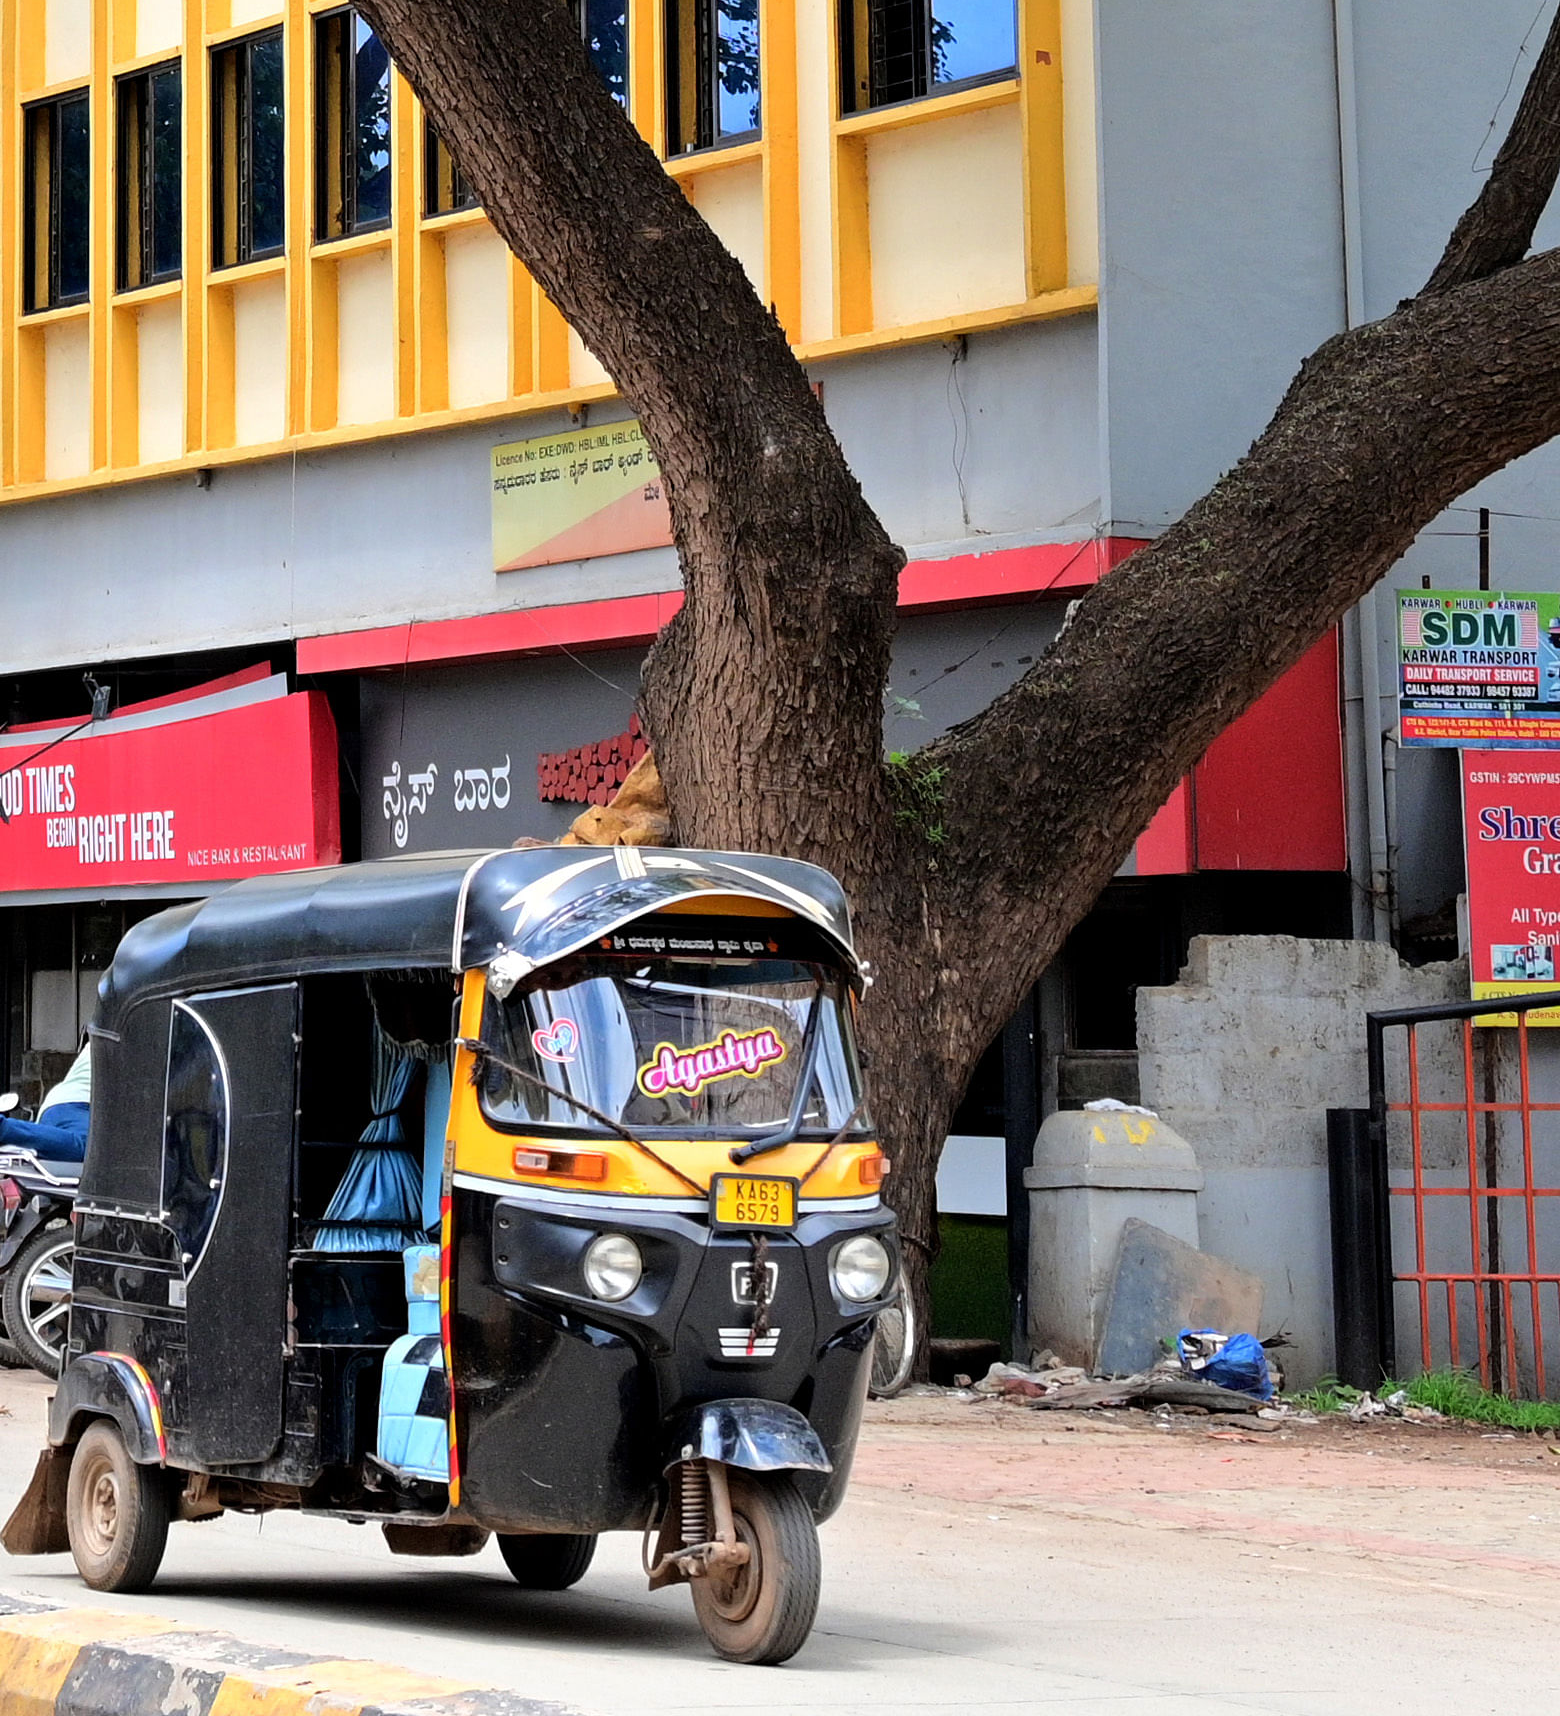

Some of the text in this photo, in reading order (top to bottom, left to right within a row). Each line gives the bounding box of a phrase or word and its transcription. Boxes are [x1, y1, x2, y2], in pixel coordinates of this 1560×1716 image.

[496, 452, 523, 467] Licence
[1402, 598, 1537, 611] KARWAR HUBLI KARWAR
[1421, 611, 1517, 647] SDM
[1402, 650, 1537, 665] KARWAR TRANSPORT
[1406, 667, 1535, 682] DAILY TRANSPORT SERVICE
[1405, 684, 1429, 696] CALL:
[1470, 772, 1500, 783] GSTIN
[25, 764, 76, 815] TIMES
[383, 761, 438, 848] ನೈಸ್
[46, 810, 176, 864] BEGIN RIGHT HERE
[187, 842, 307, 866] NICE BAR & RESTAURANT
[1511, 908, 1530, 923] All
[644, 1030, 782, 1092] Agastya
[736, 1180, 780, 1202] KA63
[736, 1202, 780, 1222] 6579
